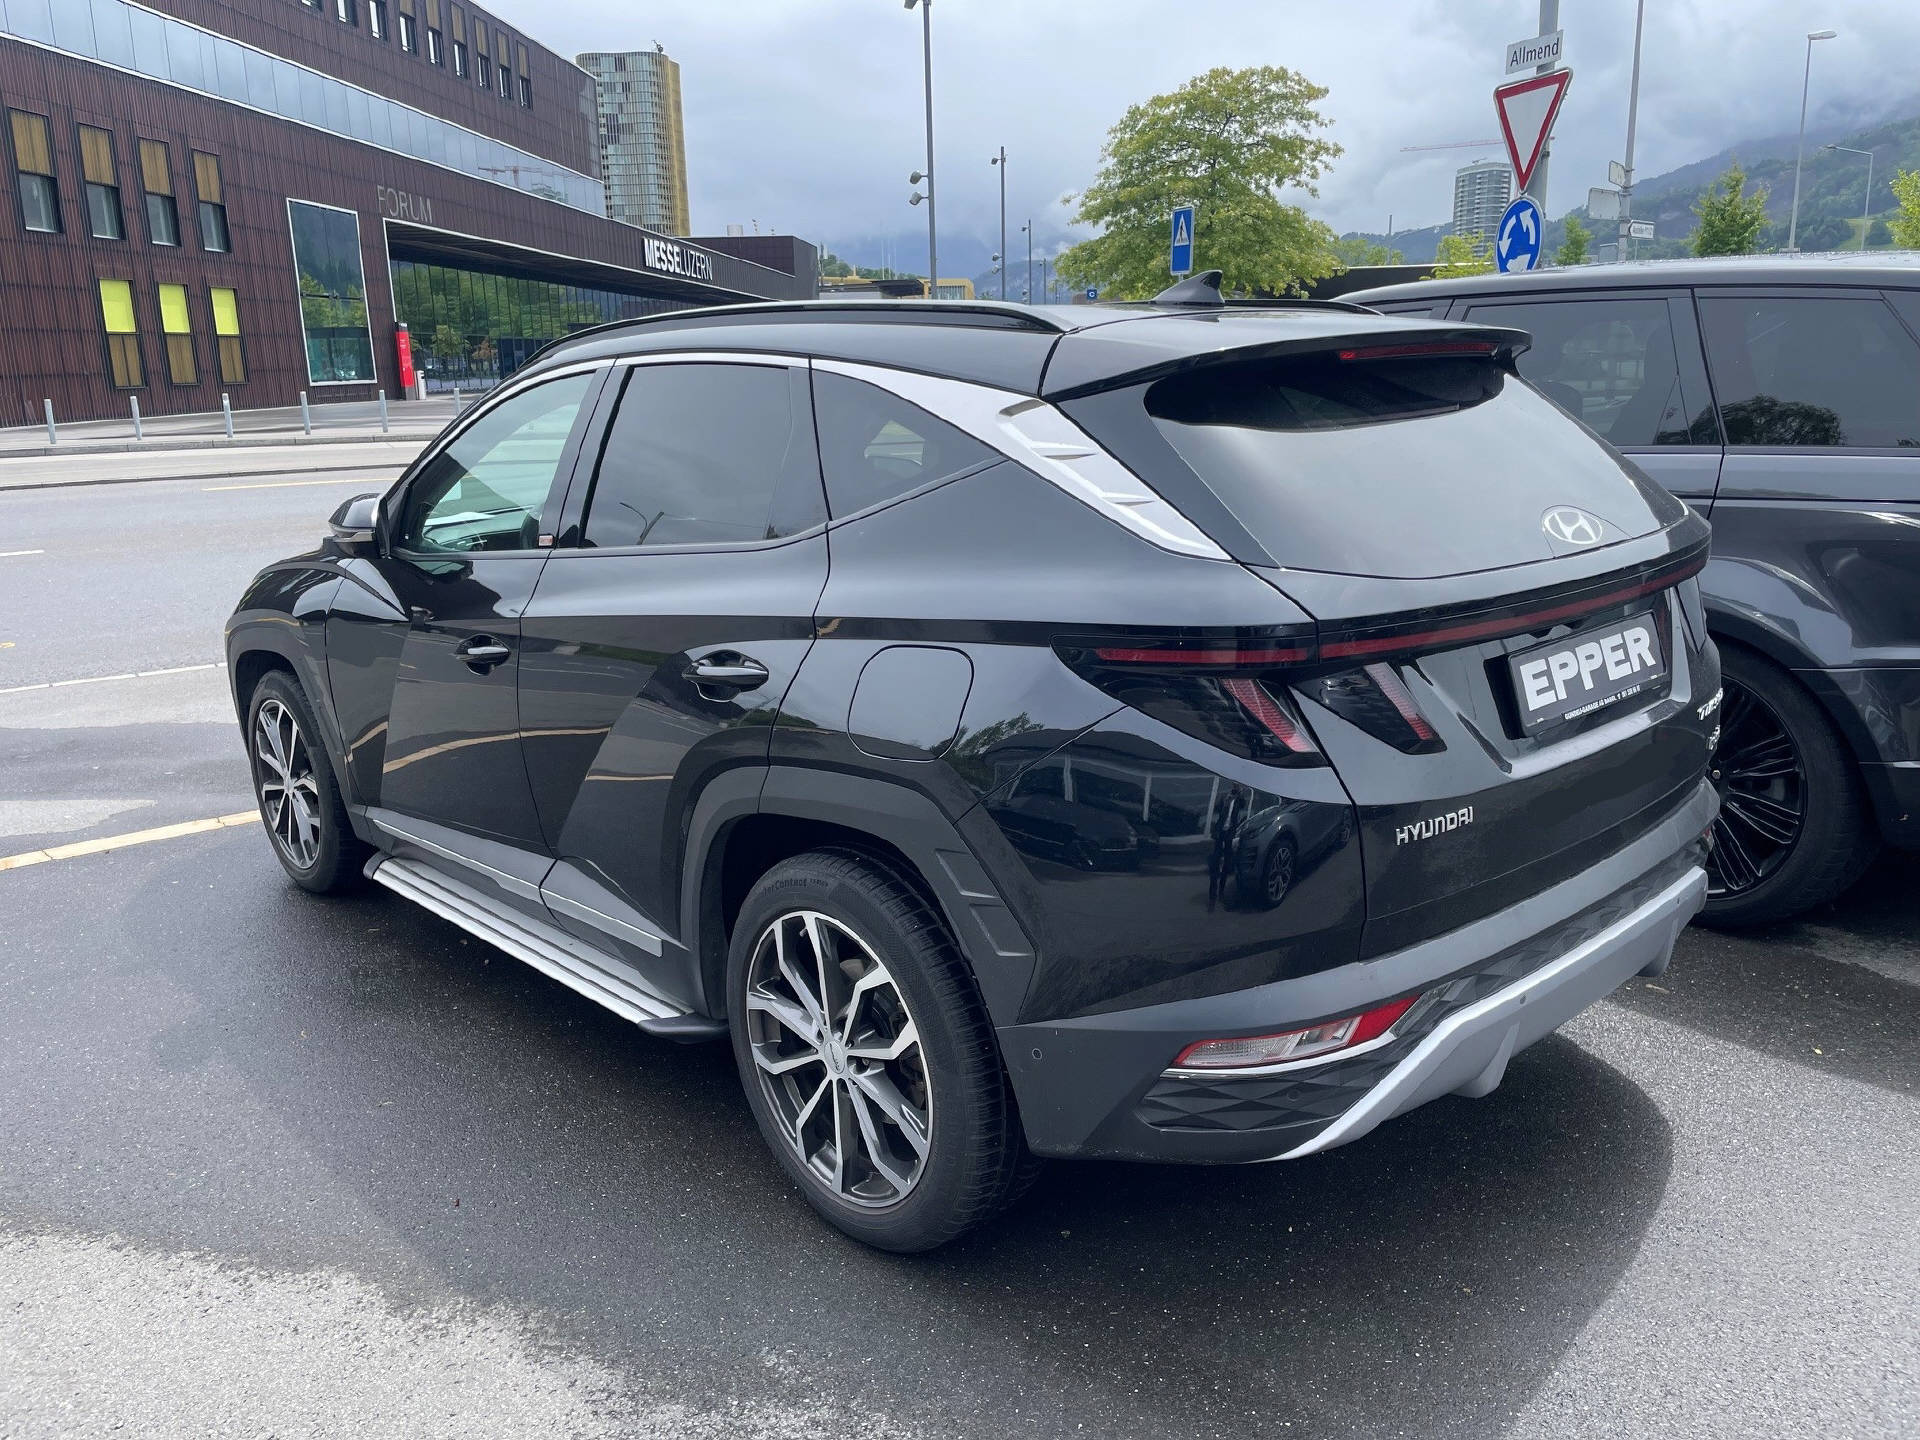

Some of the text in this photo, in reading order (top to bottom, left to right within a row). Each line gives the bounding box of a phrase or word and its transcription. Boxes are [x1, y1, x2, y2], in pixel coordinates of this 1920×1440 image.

[1510, 37, 1559, 67] Allmend
[377, 185, 433, 224] FORUM
[1519, 626, 1656, 712] EPPER
[1395, 806, 1474, 846] HYUNDAI
